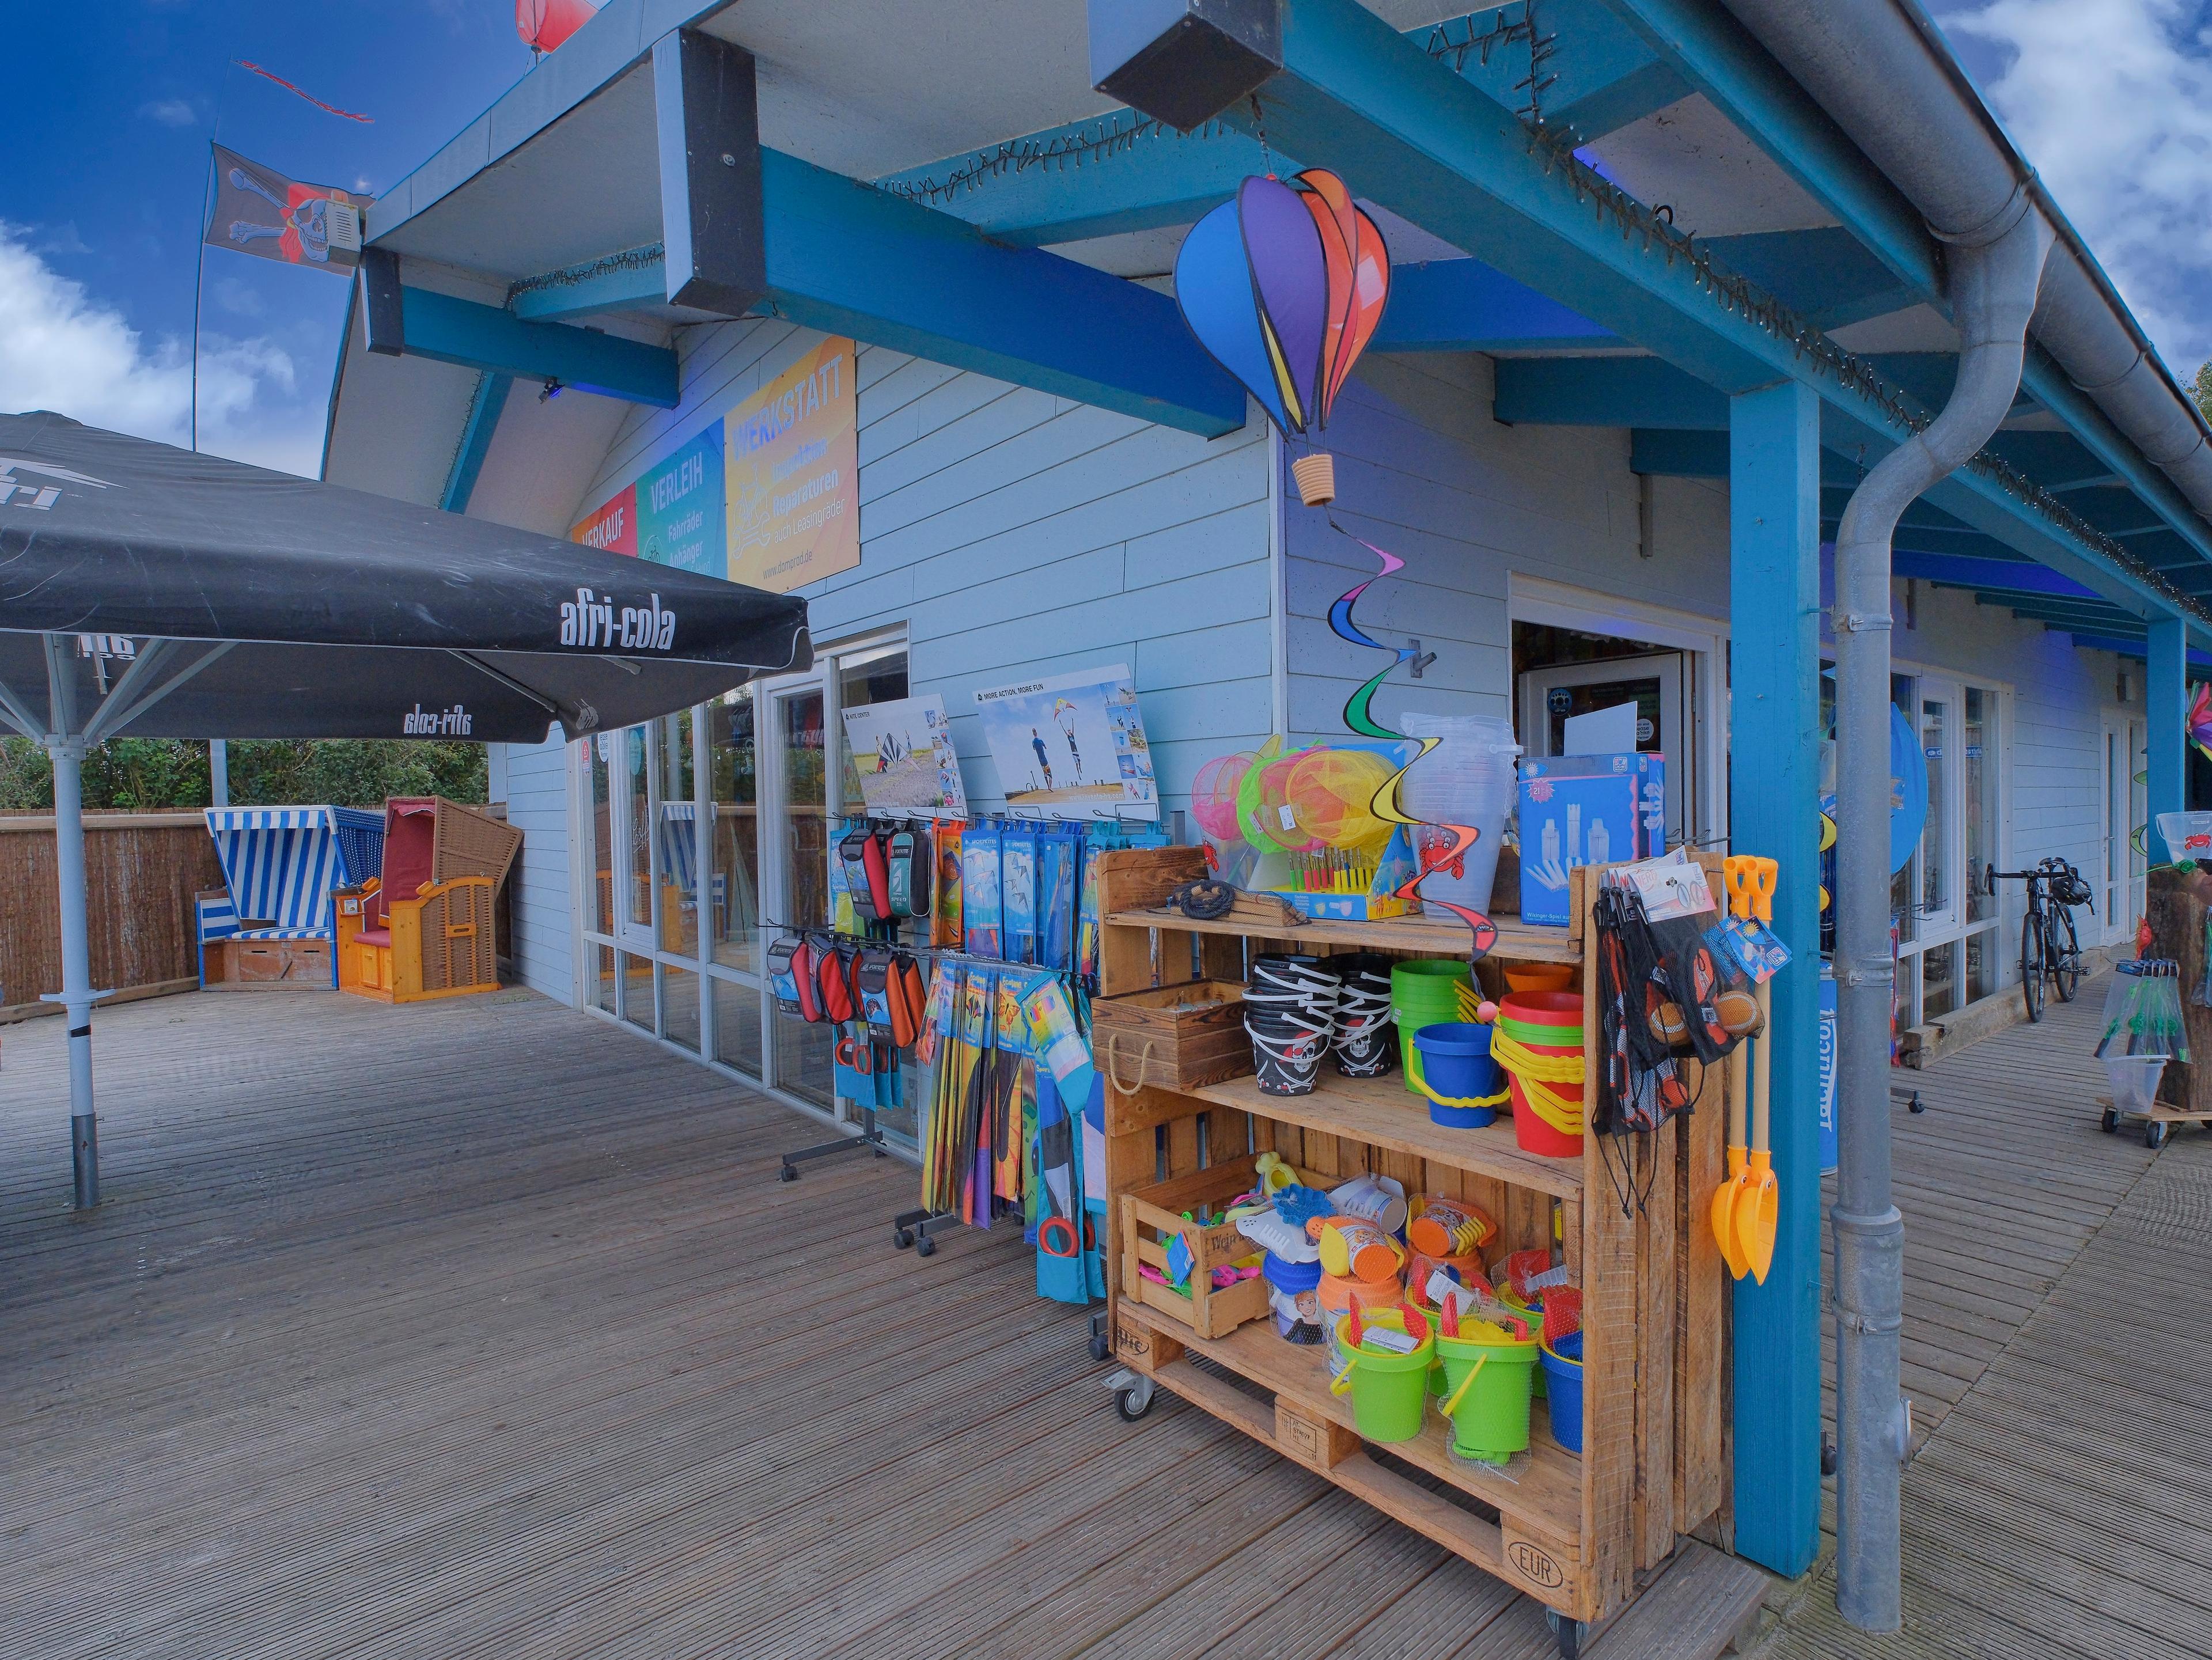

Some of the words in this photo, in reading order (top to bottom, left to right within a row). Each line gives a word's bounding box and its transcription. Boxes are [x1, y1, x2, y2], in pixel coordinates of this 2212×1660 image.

[732, 353, 843, 461] WERKSTATT
[650, 451, 703, 515] VERLEIH
[772, 469, 839, 517] Reparaturen
[668, 510, 703, 544] Fahrräder
[774, 521, 791, 544] auch
[793, 497, 845, 535] Leasingräder
[669, 540, 704, 568] Anhänger
[560, 588, 676, 650] afri-cola
[984, 692, 998, 700] MORE
[998, 688, 1018, 697] ACTION,
[1017, 685, 1033, 695] MORE
[1033, 683, 1044, 691] FUN
[1520, 1545, 1551, 1583] EUR
